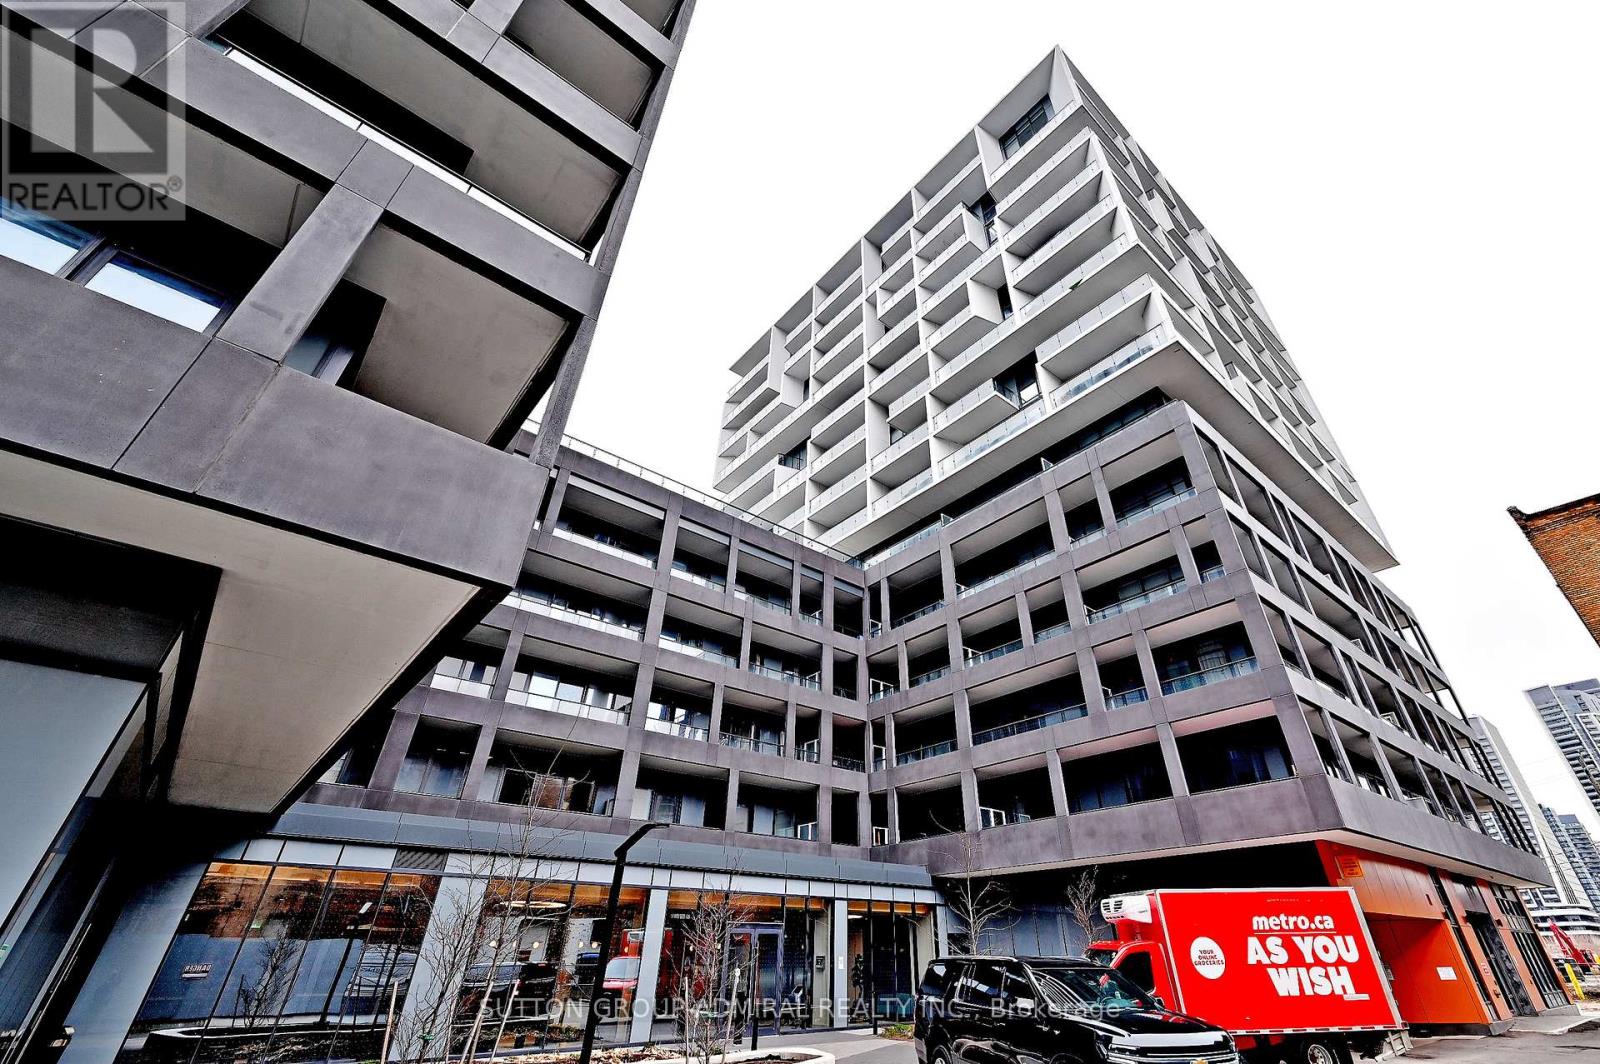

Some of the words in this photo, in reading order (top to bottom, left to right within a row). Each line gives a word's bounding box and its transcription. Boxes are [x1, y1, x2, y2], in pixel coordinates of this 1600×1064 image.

[1252, 913, 1335, 930] metro.ca
[1247, 936, 1289, 964] AS
[1291, 935, 1360, 963] YOU
[1266, 966, 1357, 996] WISH
